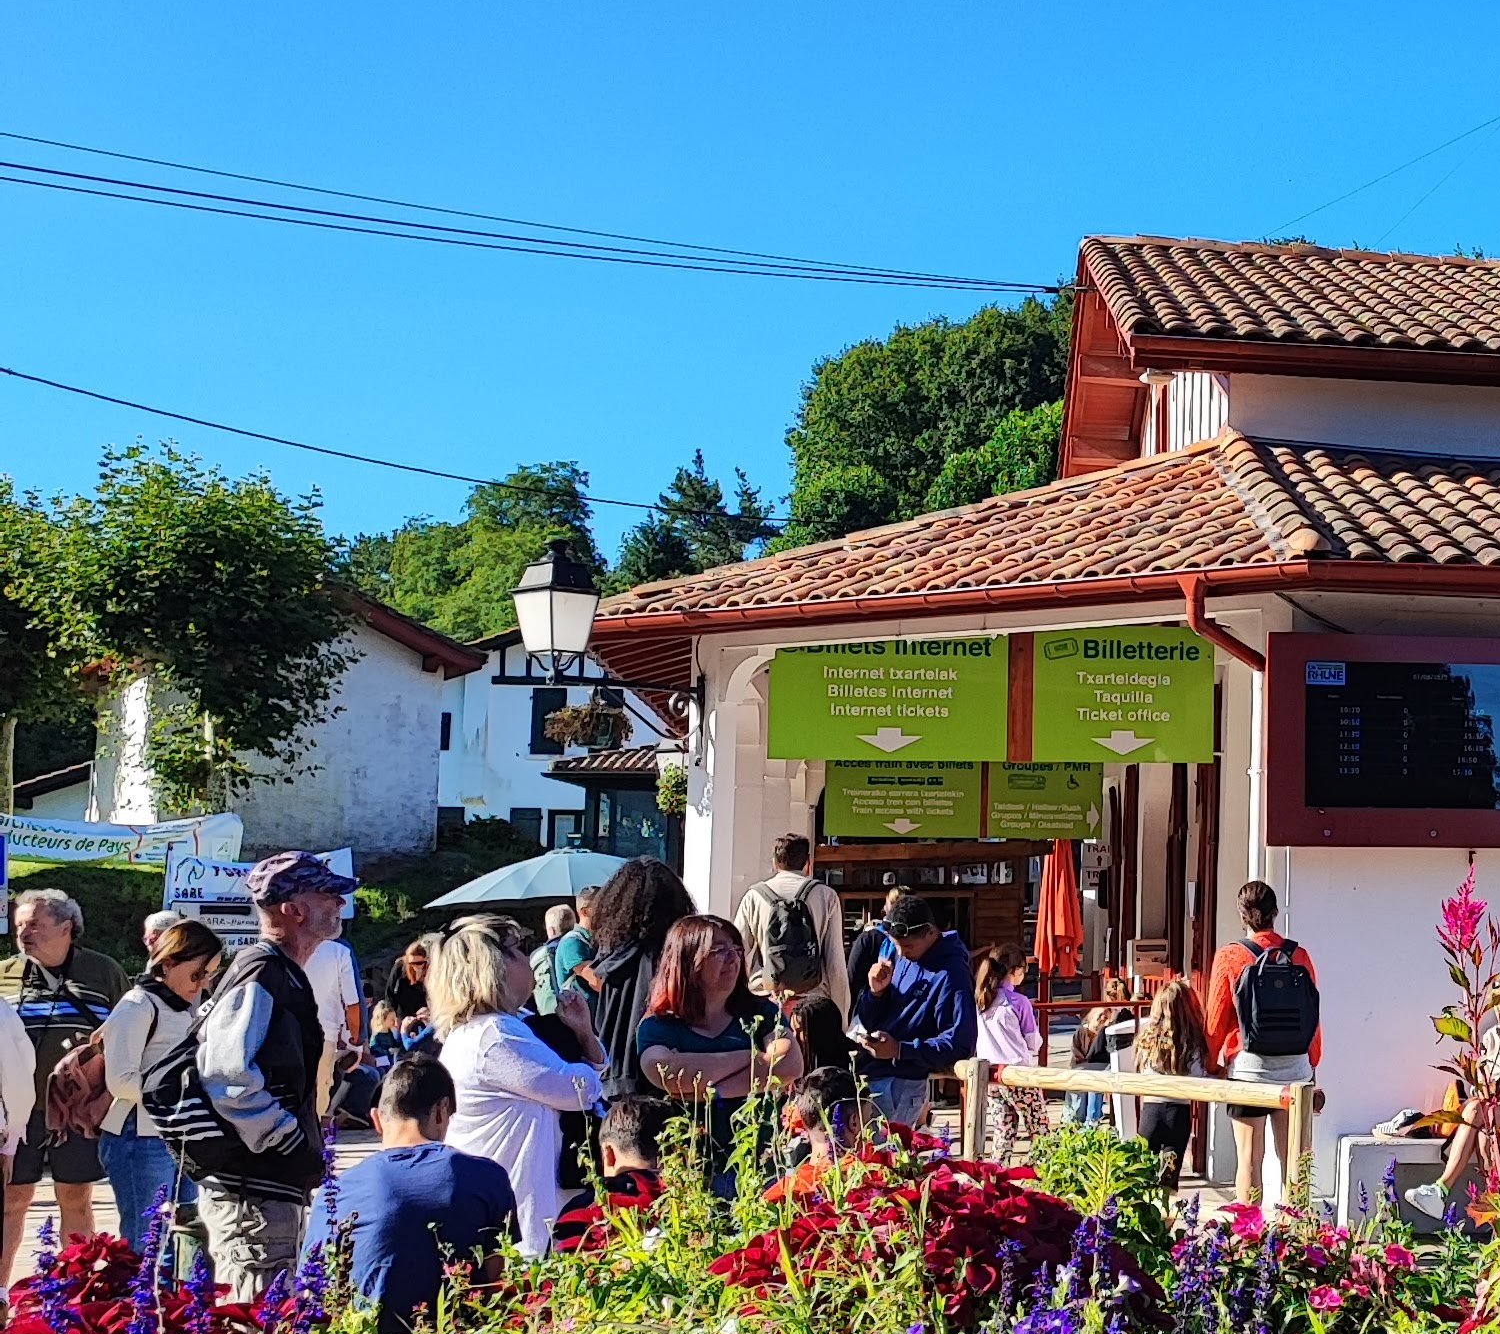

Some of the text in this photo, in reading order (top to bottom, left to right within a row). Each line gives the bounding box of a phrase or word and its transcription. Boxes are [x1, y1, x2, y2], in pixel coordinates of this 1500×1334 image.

[895, 639, 992, 657] Internet
[1083, 639, 1200, 661] Billetterie
[823, 666, 958, 681] Internet txartelak
[1076, 671, 1171, 688] Txarteldegia
[828, 684, 953, 699] Billetes Internet
[1094, 690, 1154, 706] Taquilla
[830, 703, 949, 718] Internet tickets
[1077, 708, 1171, 722] Ticket office
[75, 837, 95, 852] de
[97, 838, 131, 855] Pays
[1087, 844, 1110, 854] TRAI
[1086, 870, 1100, 880] TR
